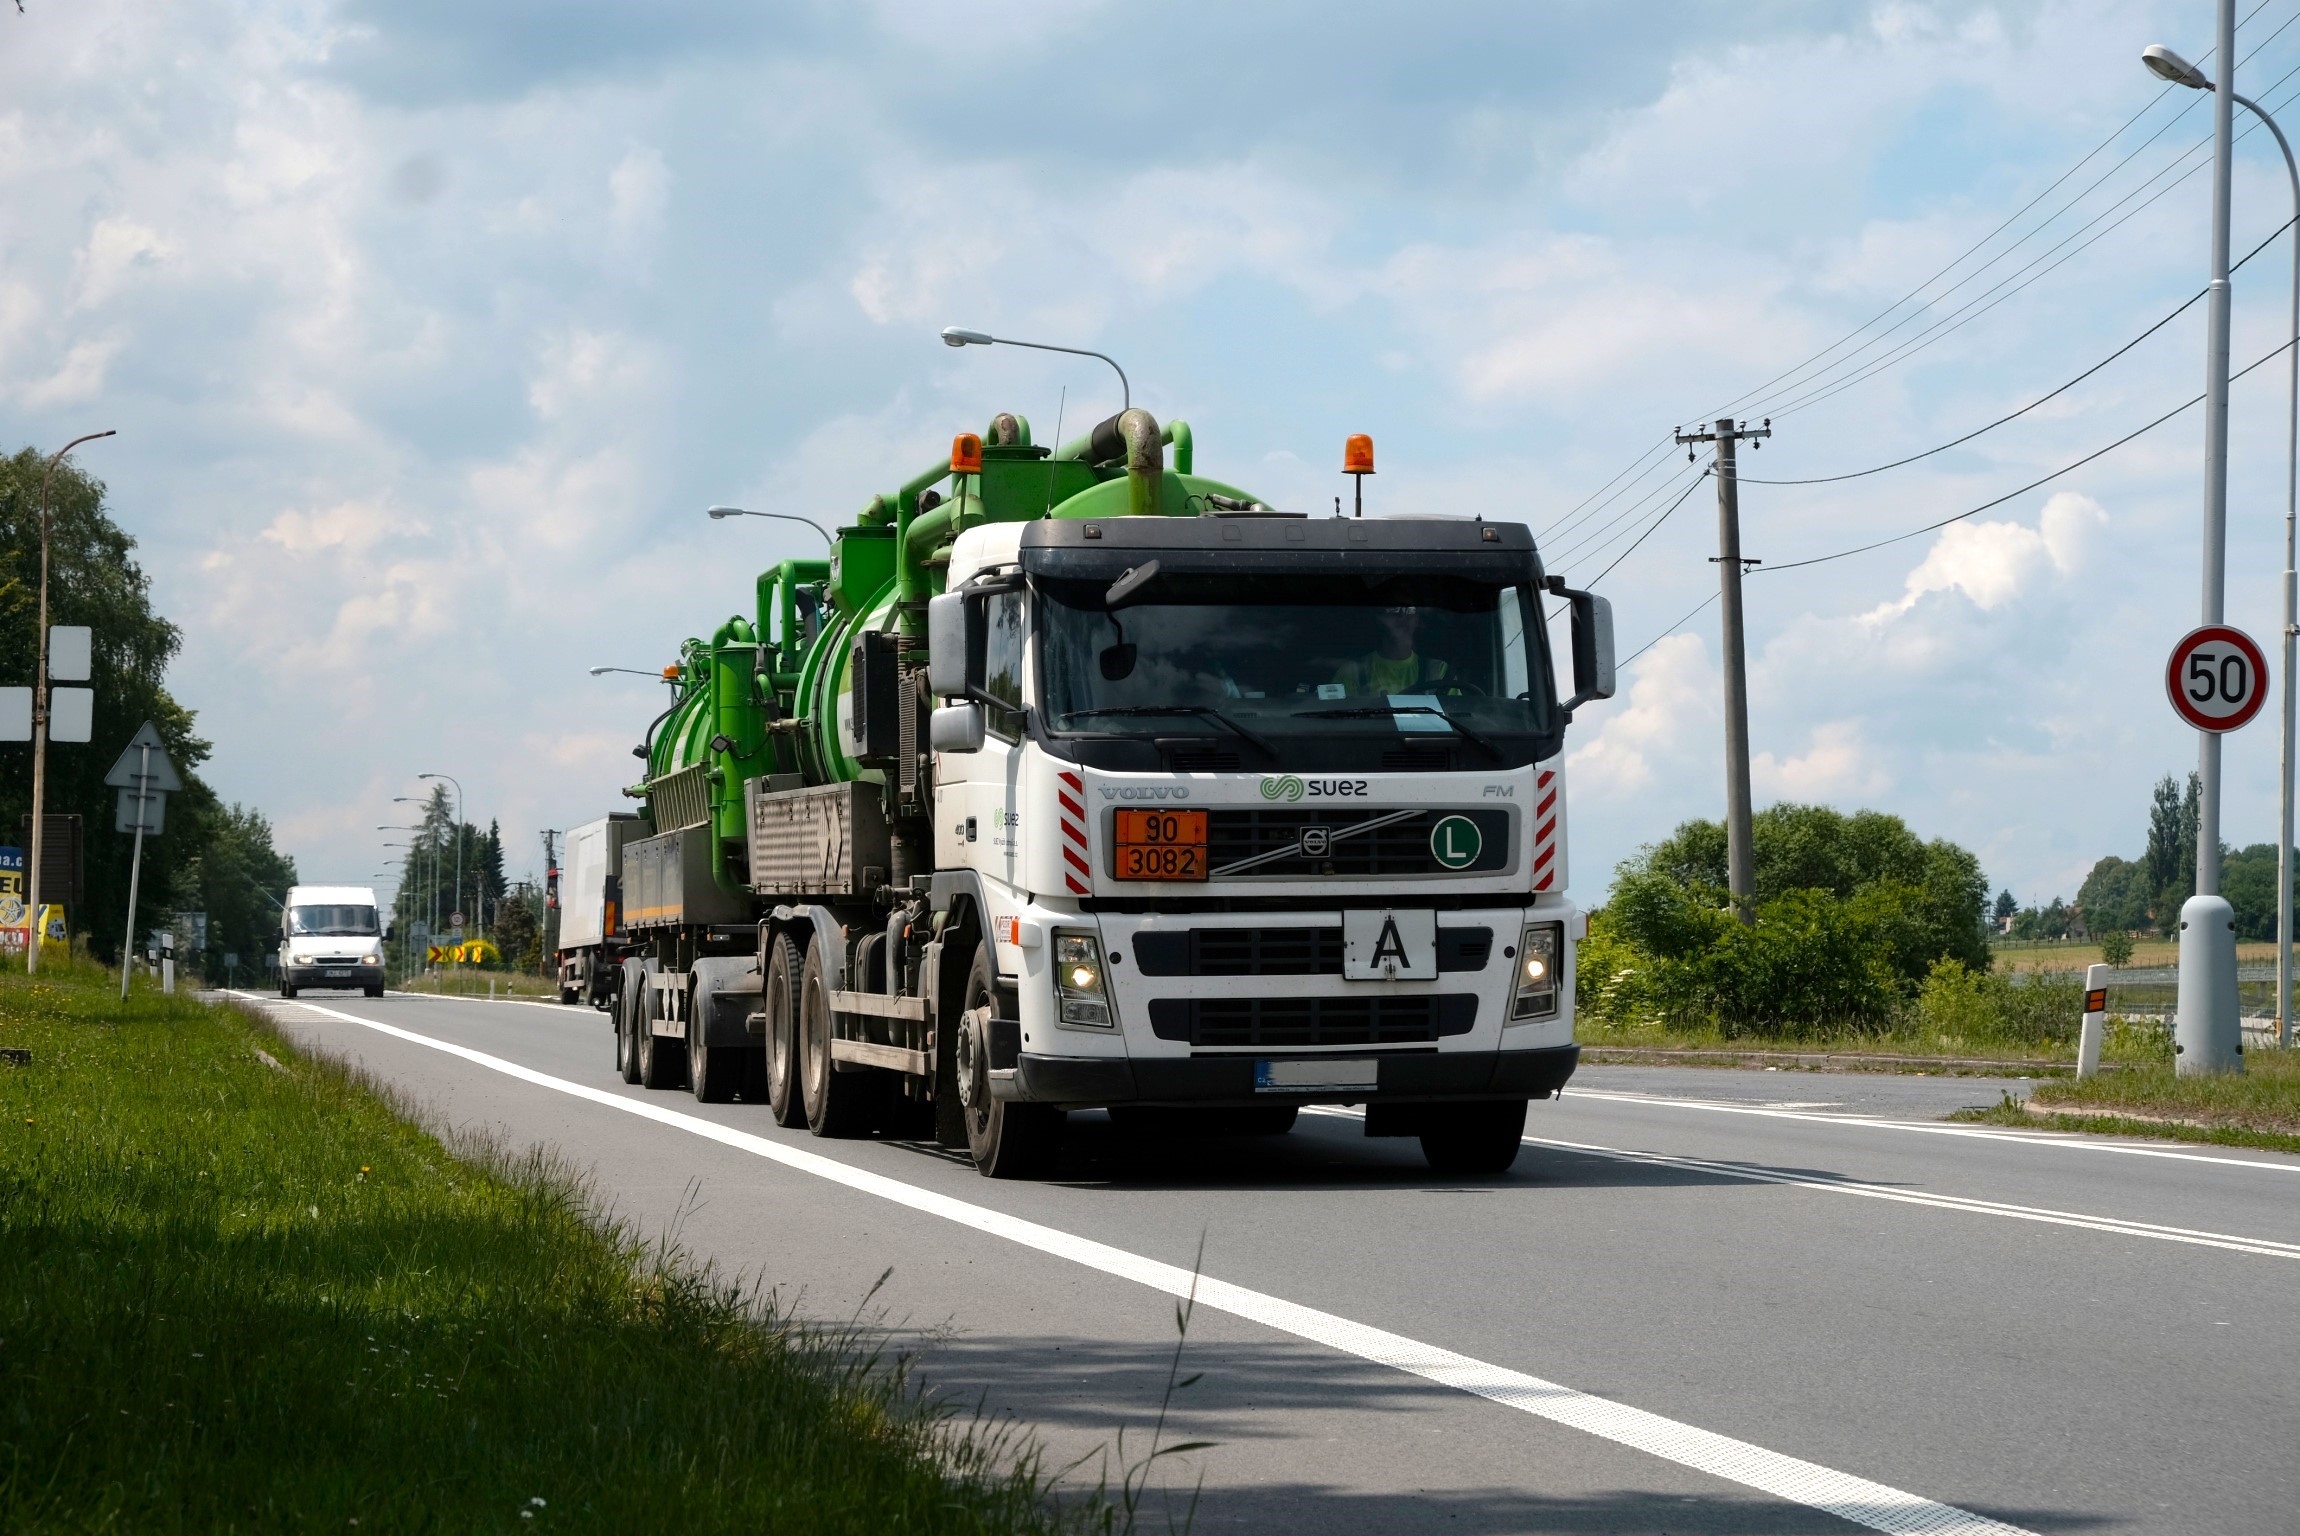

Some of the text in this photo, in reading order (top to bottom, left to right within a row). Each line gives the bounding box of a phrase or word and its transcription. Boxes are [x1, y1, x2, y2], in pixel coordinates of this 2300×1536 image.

[2189, 654, 2247, 704] 50
[1097, 786, 1190, 800] VOLVO
[1483, 785, 1515, 797] FM
[1146, 815, 1178, 842] 90
[1446, 826, 1467, 858] L
[1129, 849, 1195, 875] 3082
[1369, 919, 1411, 969] A
